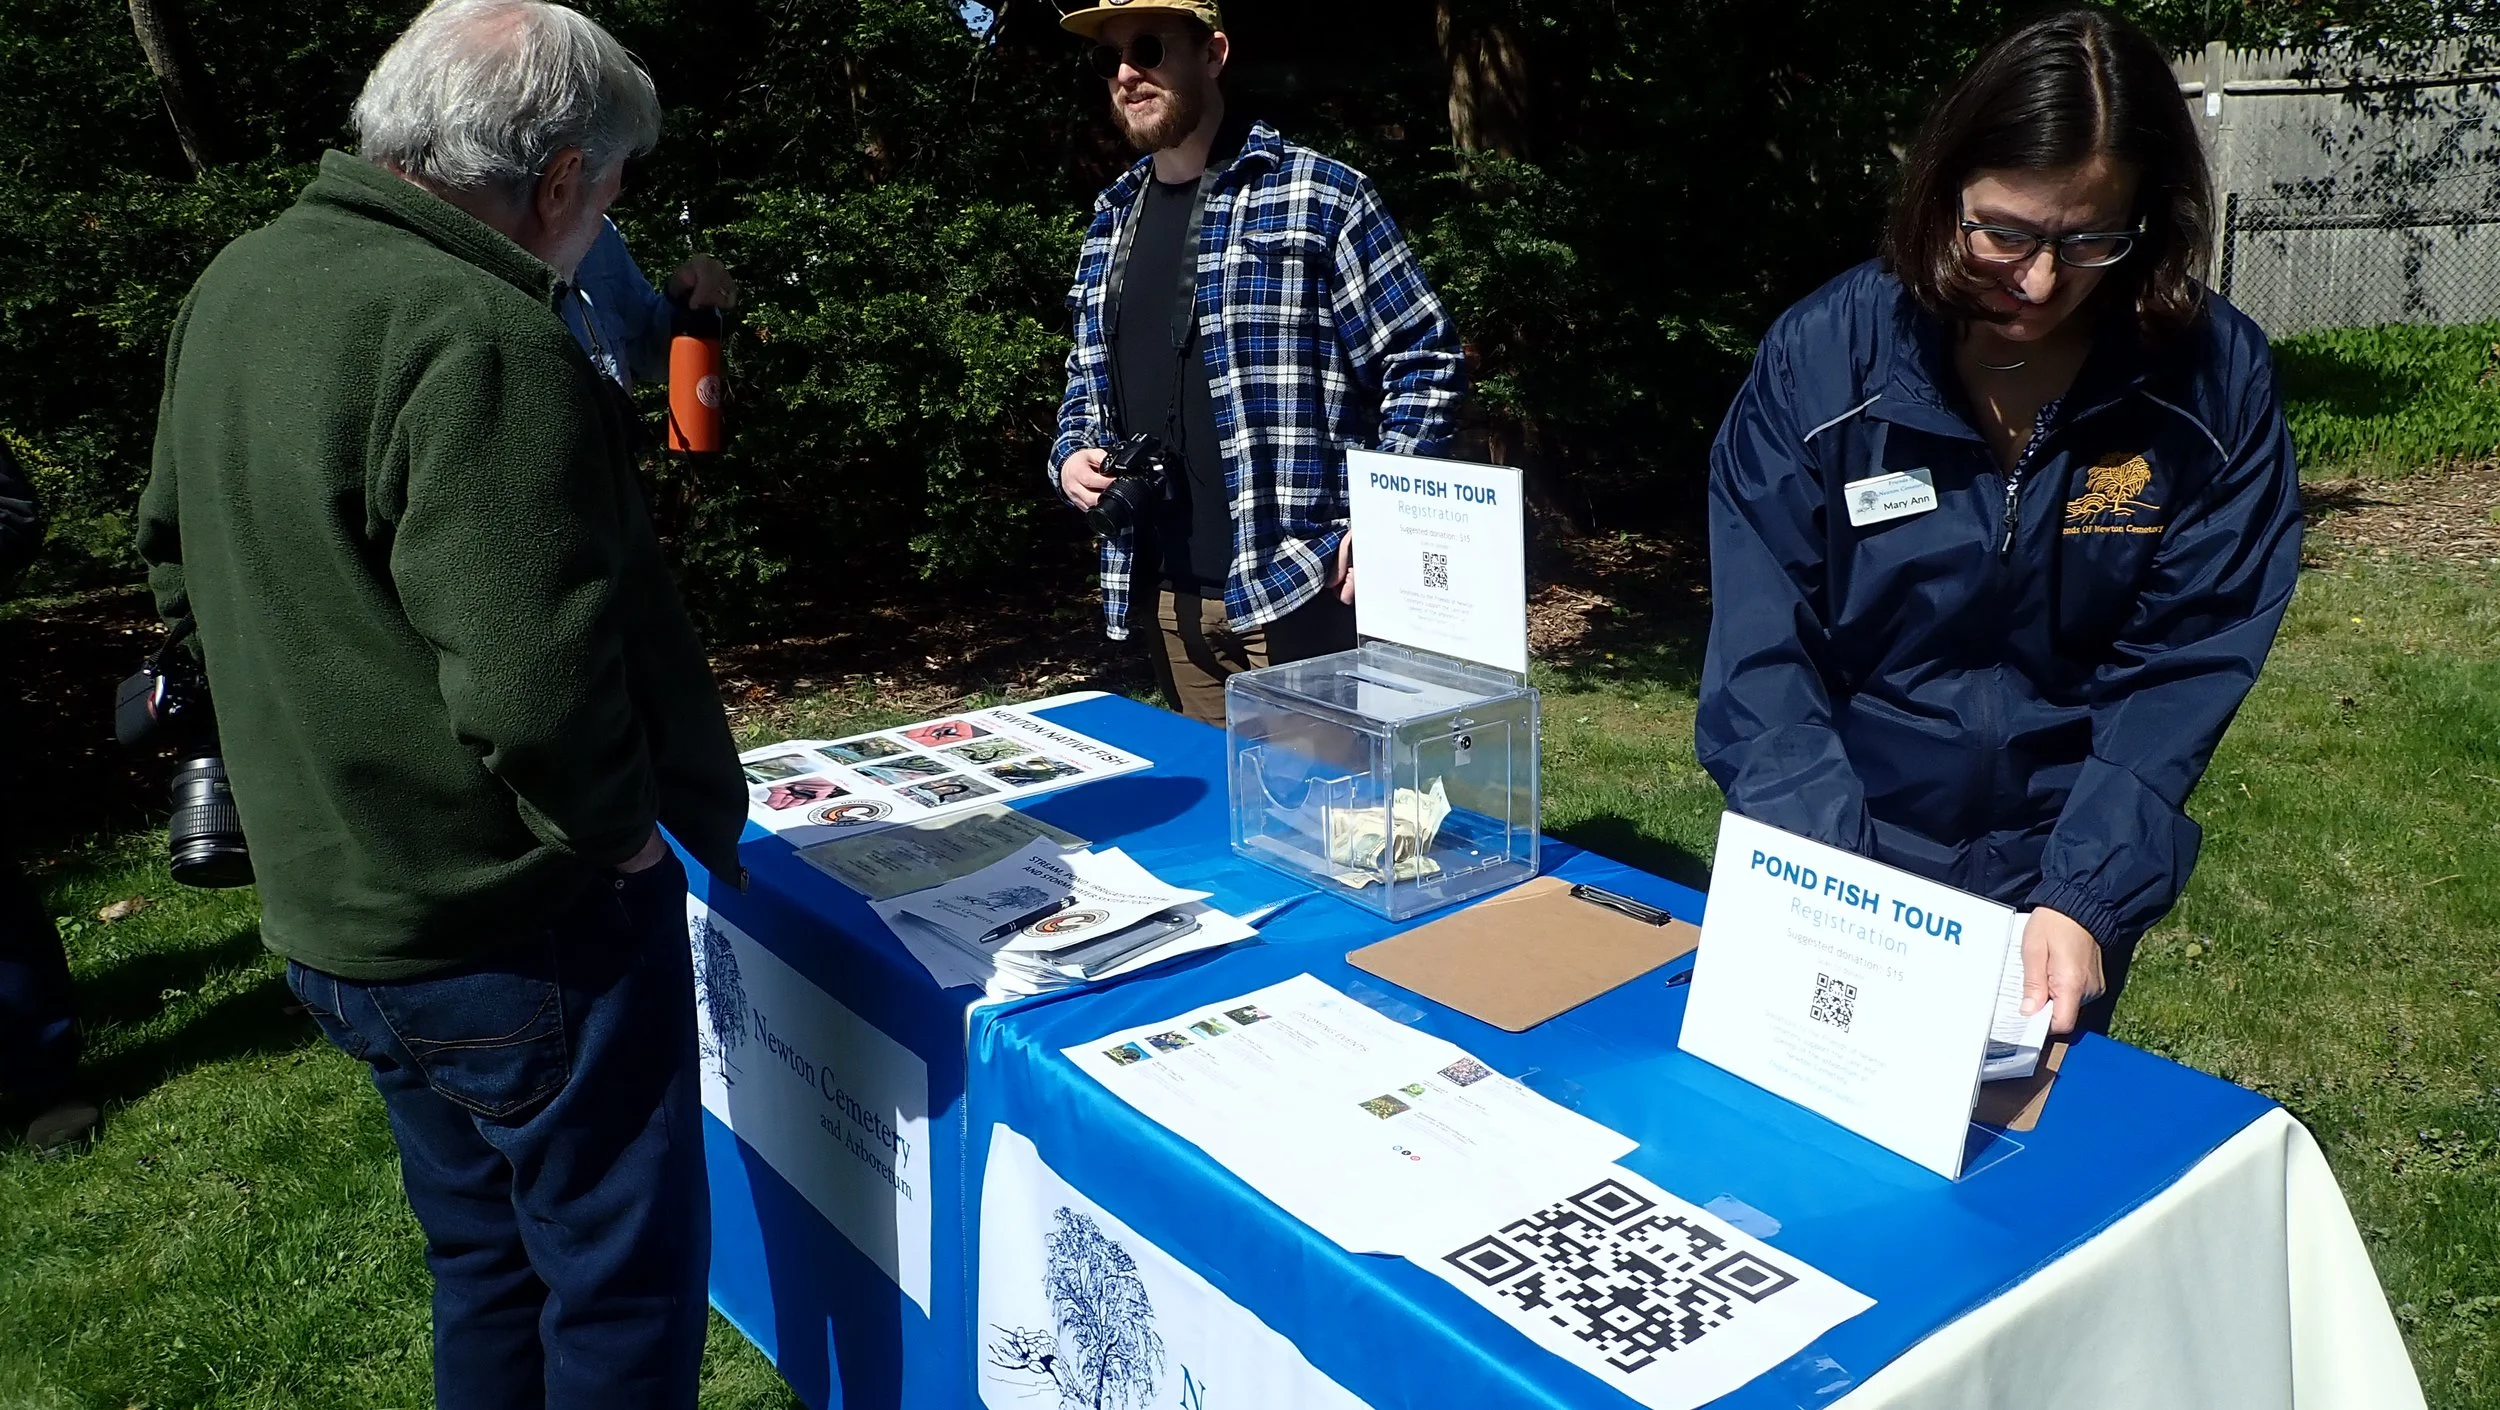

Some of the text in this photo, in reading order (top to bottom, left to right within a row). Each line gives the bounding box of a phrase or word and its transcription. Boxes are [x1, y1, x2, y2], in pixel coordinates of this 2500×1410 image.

[1371, 472, 1497, 505] POND FISH TOUR
[1884, 495, 1930, 511] Mary Ann
[1398, 500, 1469, 524] Registration
[2094, 525, 2124, 533] Newton
[2126, 524, 2164, 533] Cemetery
[988, 710, 1047, 734] NEWTON
[1042, 731, 1094, 753] NATIVE
[1090, 750, 1130, 766] FISH
[1022, 865, 1044, 877] AND
[1029, 855, 1065, 876] STREAM,
[1751, 849, 1963, 945] POND FISH TOUR
[1790, 896, 1908, 956] Registration
[1787, 927, 1834, 954] Suggested
[1886, 965, 1904, 982] $15
[753, 1008, 911, 1168] Newton Cemetery
[820, 1114, 913, 1201] and Arboretum
